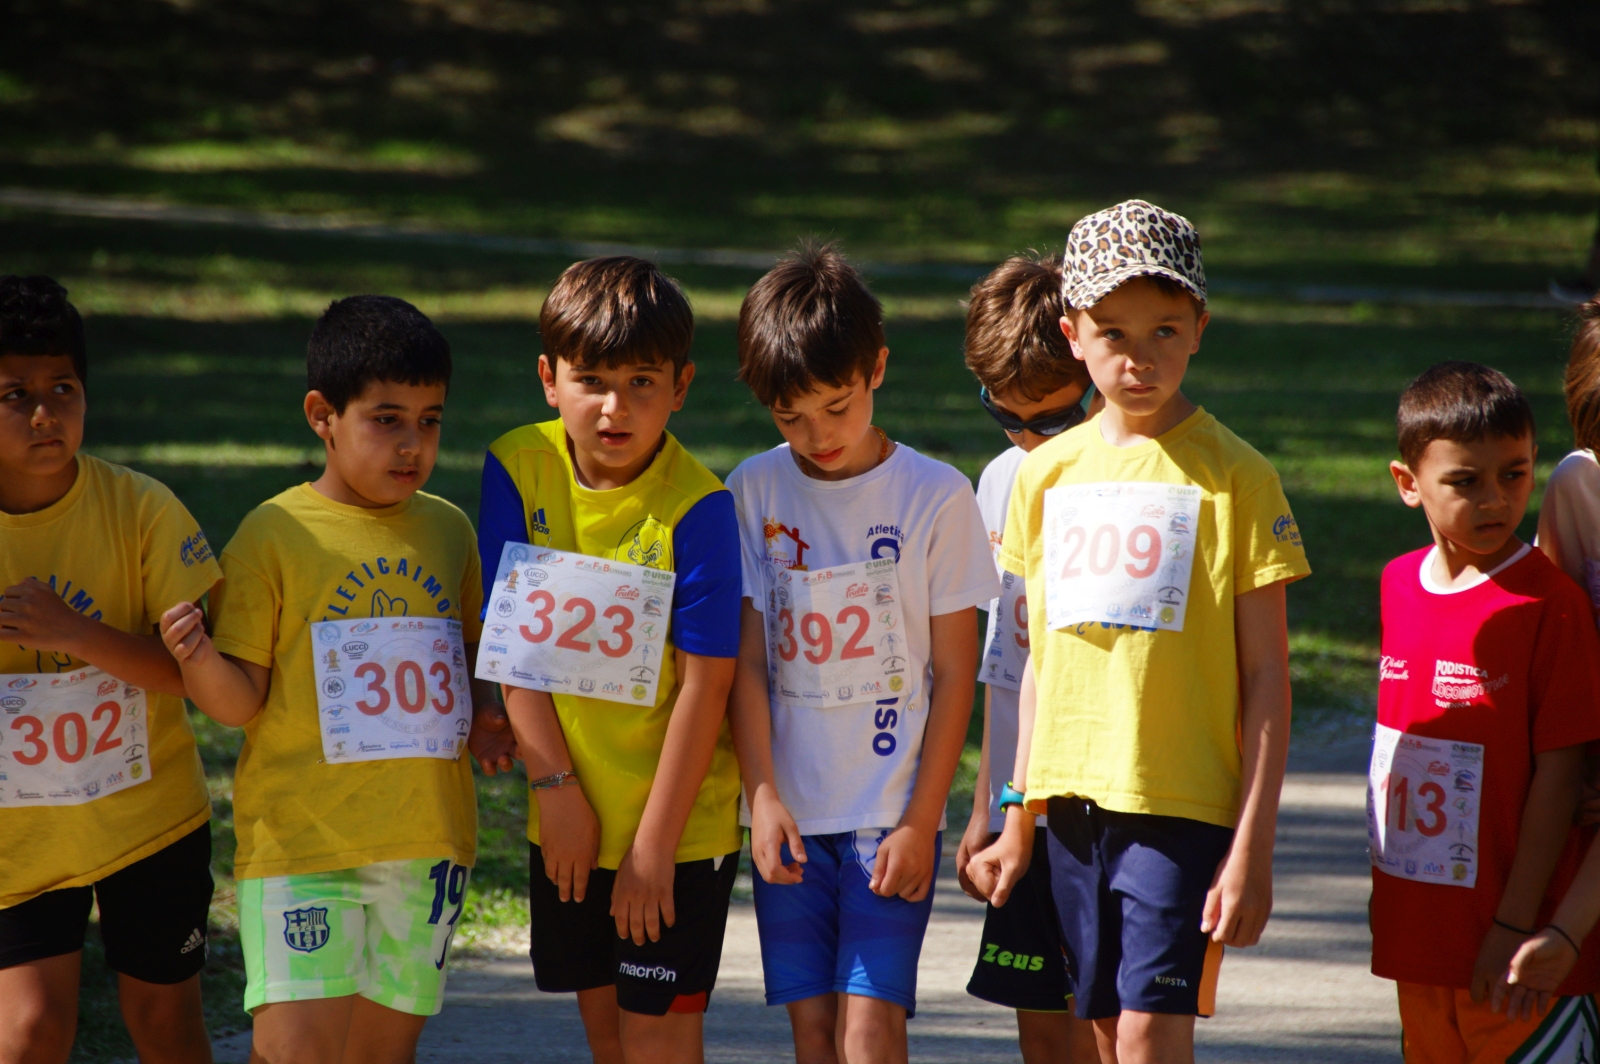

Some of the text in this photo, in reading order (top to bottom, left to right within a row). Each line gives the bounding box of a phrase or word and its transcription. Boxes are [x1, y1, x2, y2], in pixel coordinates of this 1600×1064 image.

[1177, 487, 1198, 496] UISP
[526, 570, 547, 578] LUCCI
[651, 571, 672, 581] UISP
[1061, 523, 1163, 579] 209
[322, 557, 454, 622] LETICAIMO
[519, 589, 635, 659] 323
[778, 605, 875, 665] 392
[354, 660, 455, 716] 303
[1435, 659, 1488, 678] PODISTICA
[1435, 698, 1471, 709] RAVENNA
[10, 700, 122, 766] 302
[1380, 772, 1447, 837] 113
[427, 860, 467, 925] 19
[982, 943, 1044, 971] Zeus
[1155, 975, 1187, 988] KIPSTA
